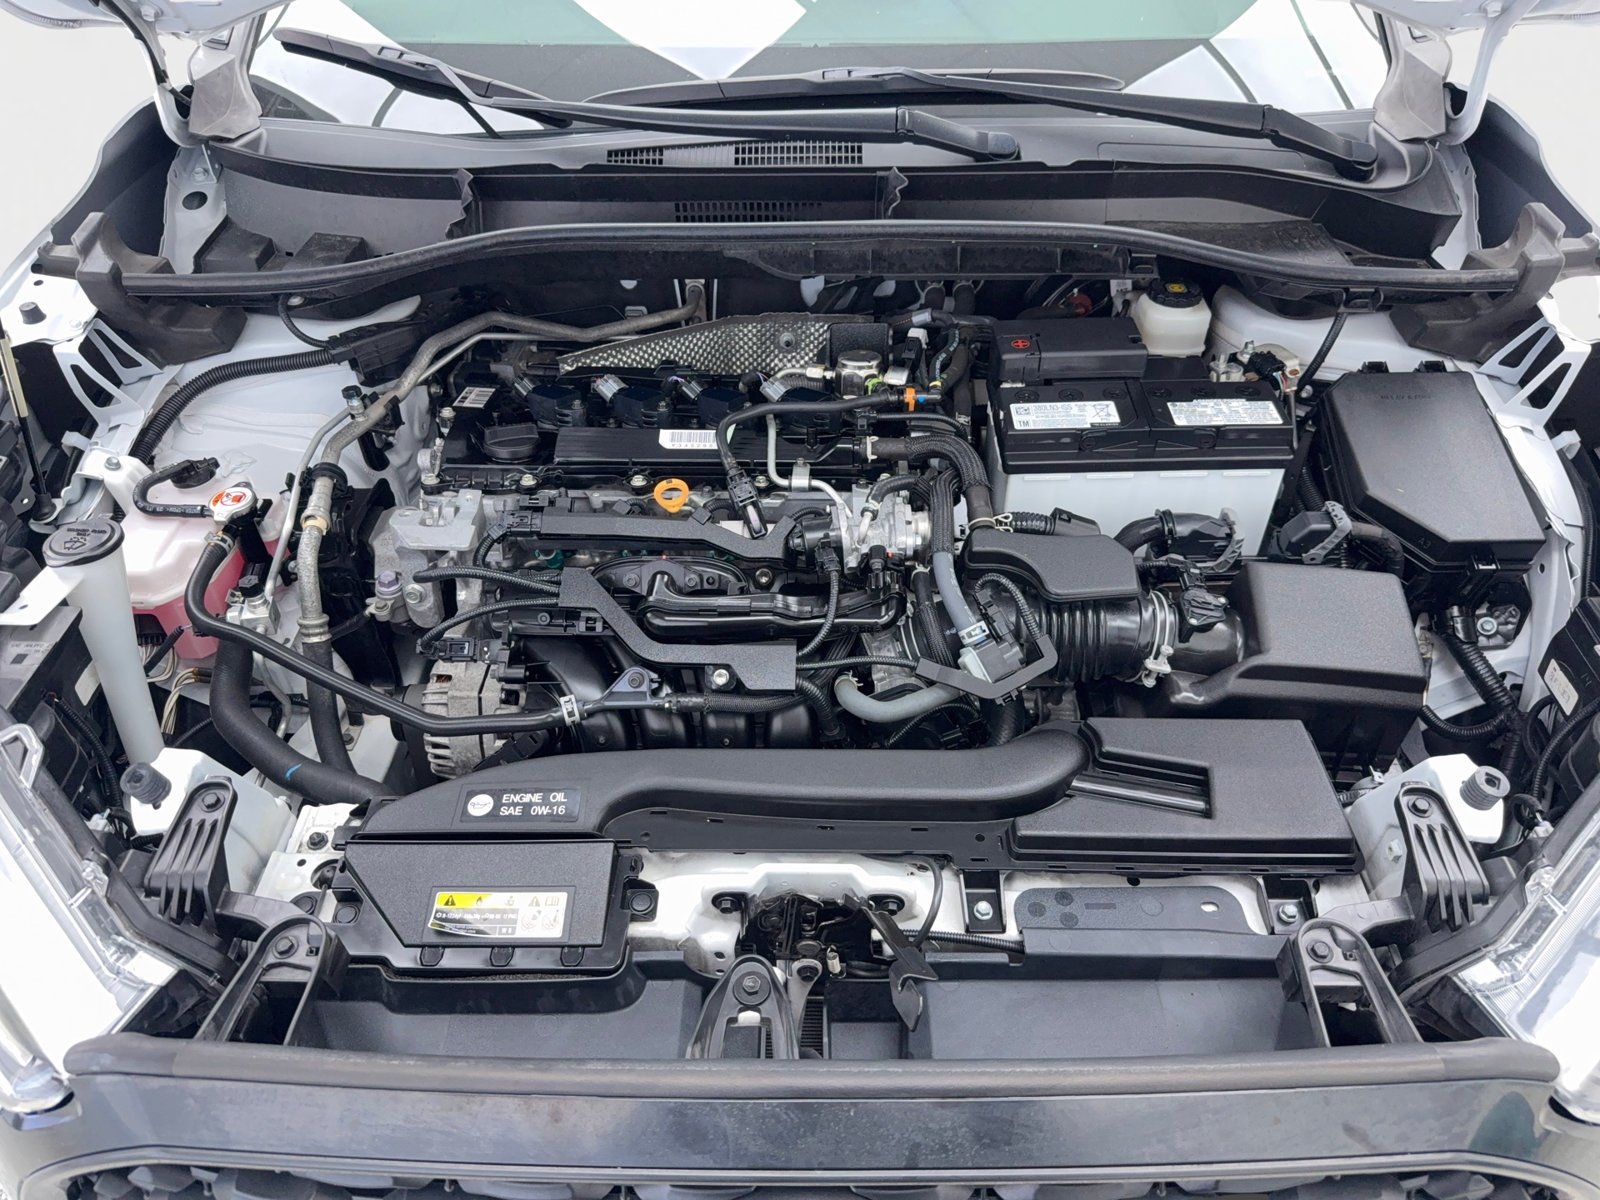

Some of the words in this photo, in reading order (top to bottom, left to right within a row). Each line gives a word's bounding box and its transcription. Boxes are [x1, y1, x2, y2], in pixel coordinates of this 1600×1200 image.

[1019, 420, 1029, 428] TM
[502, 793, 543, 803] ENGINE
[549, 792, 567, 802] OIL
[499, 806, 523, 816] SAE
[530, 805, 566, 815] 0W-16
